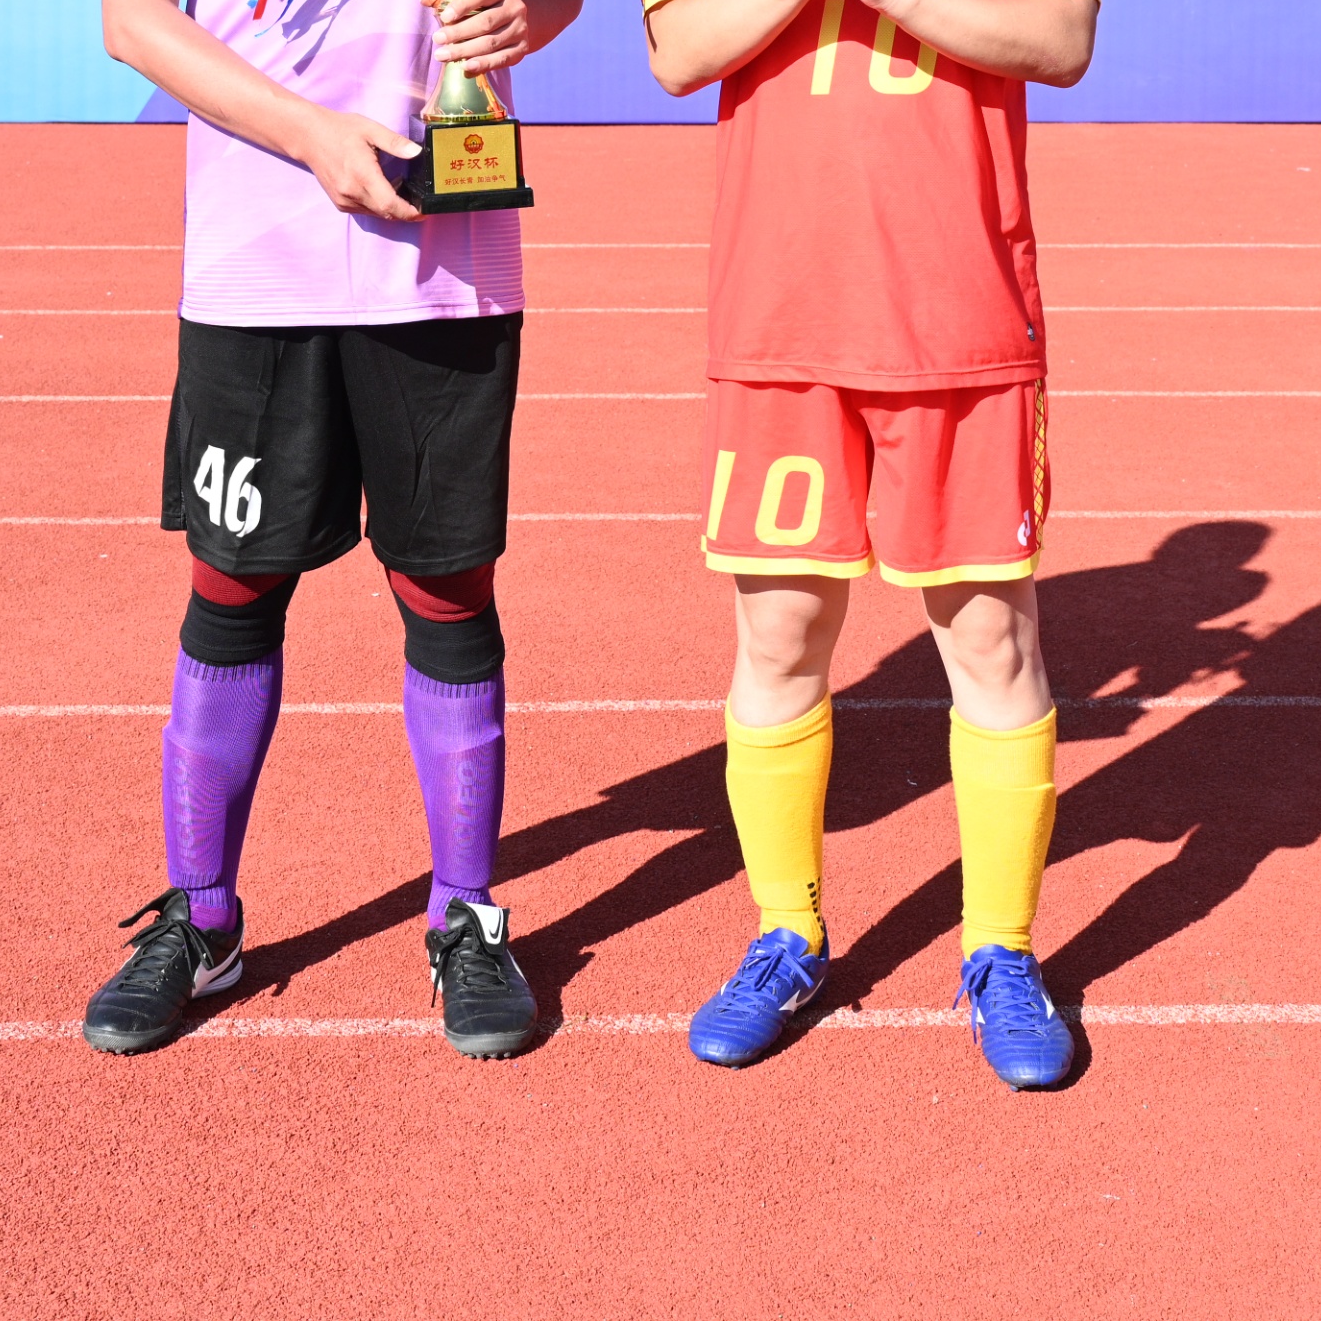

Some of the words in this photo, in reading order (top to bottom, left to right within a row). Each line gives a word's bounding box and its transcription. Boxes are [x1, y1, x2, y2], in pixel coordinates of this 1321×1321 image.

[450, 157, 499, 171] 好汉杯
[193, 444, 262, 538] 46
[706, 449, 825, 546] 10
